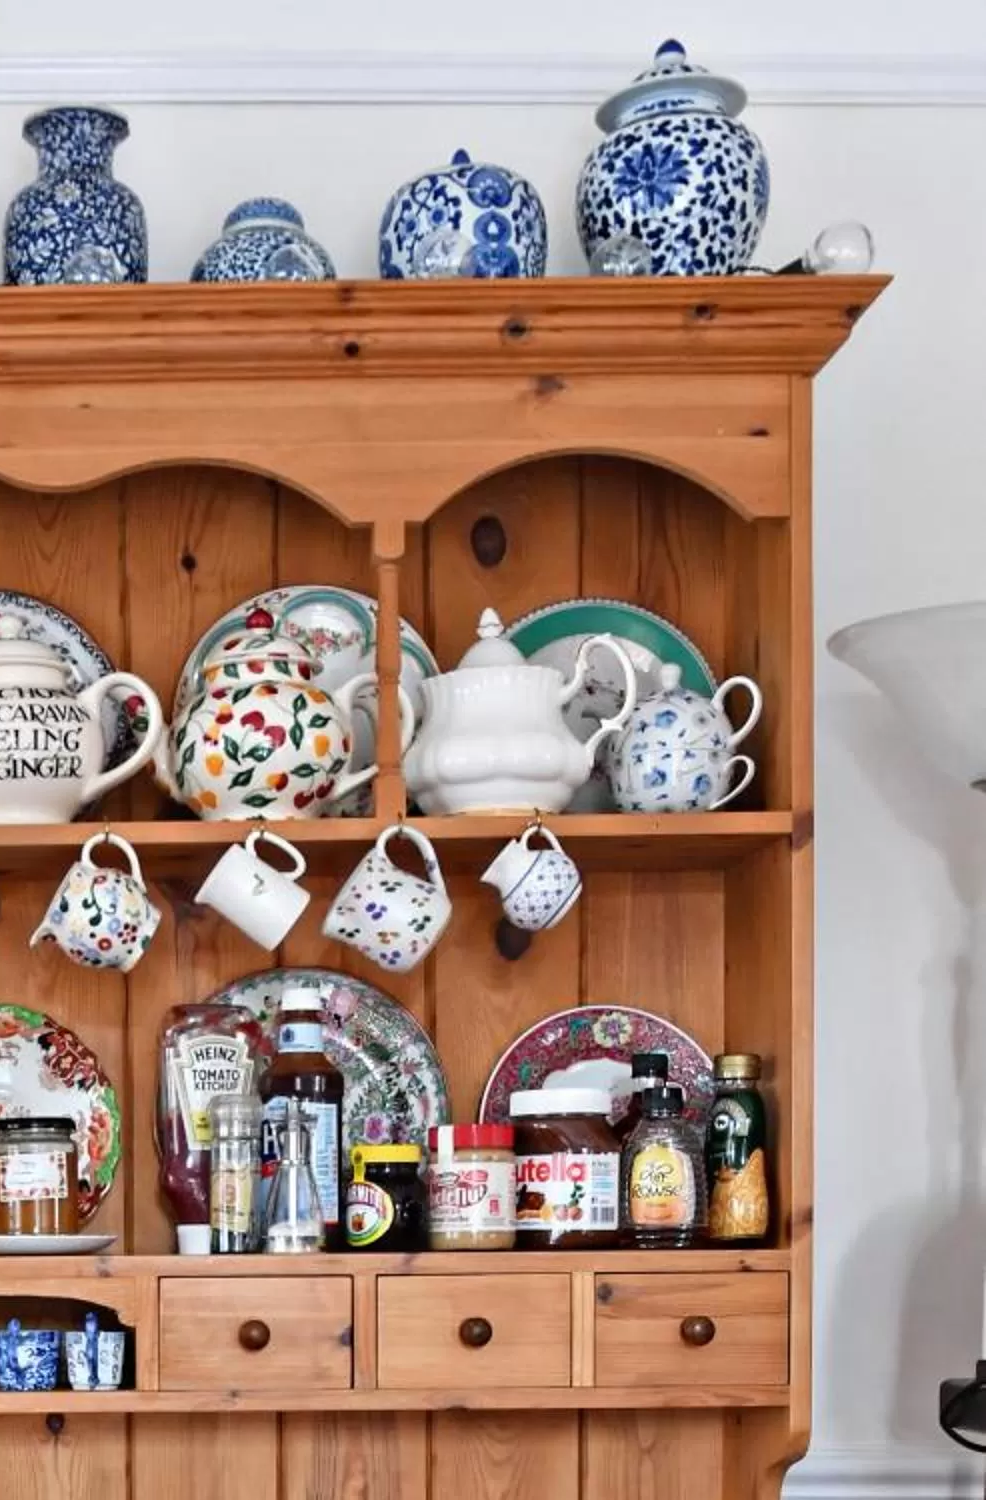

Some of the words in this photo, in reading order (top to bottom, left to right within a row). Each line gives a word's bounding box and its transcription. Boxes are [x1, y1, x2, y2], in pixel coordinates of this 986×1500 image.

[194, 1045, 237, 1063] HEINZ
[191, 1068, 241, 1082] TOMATO
[194, 1080, 239, 1092] KETCHUP
[513, 1153, 585, 1183] utella
